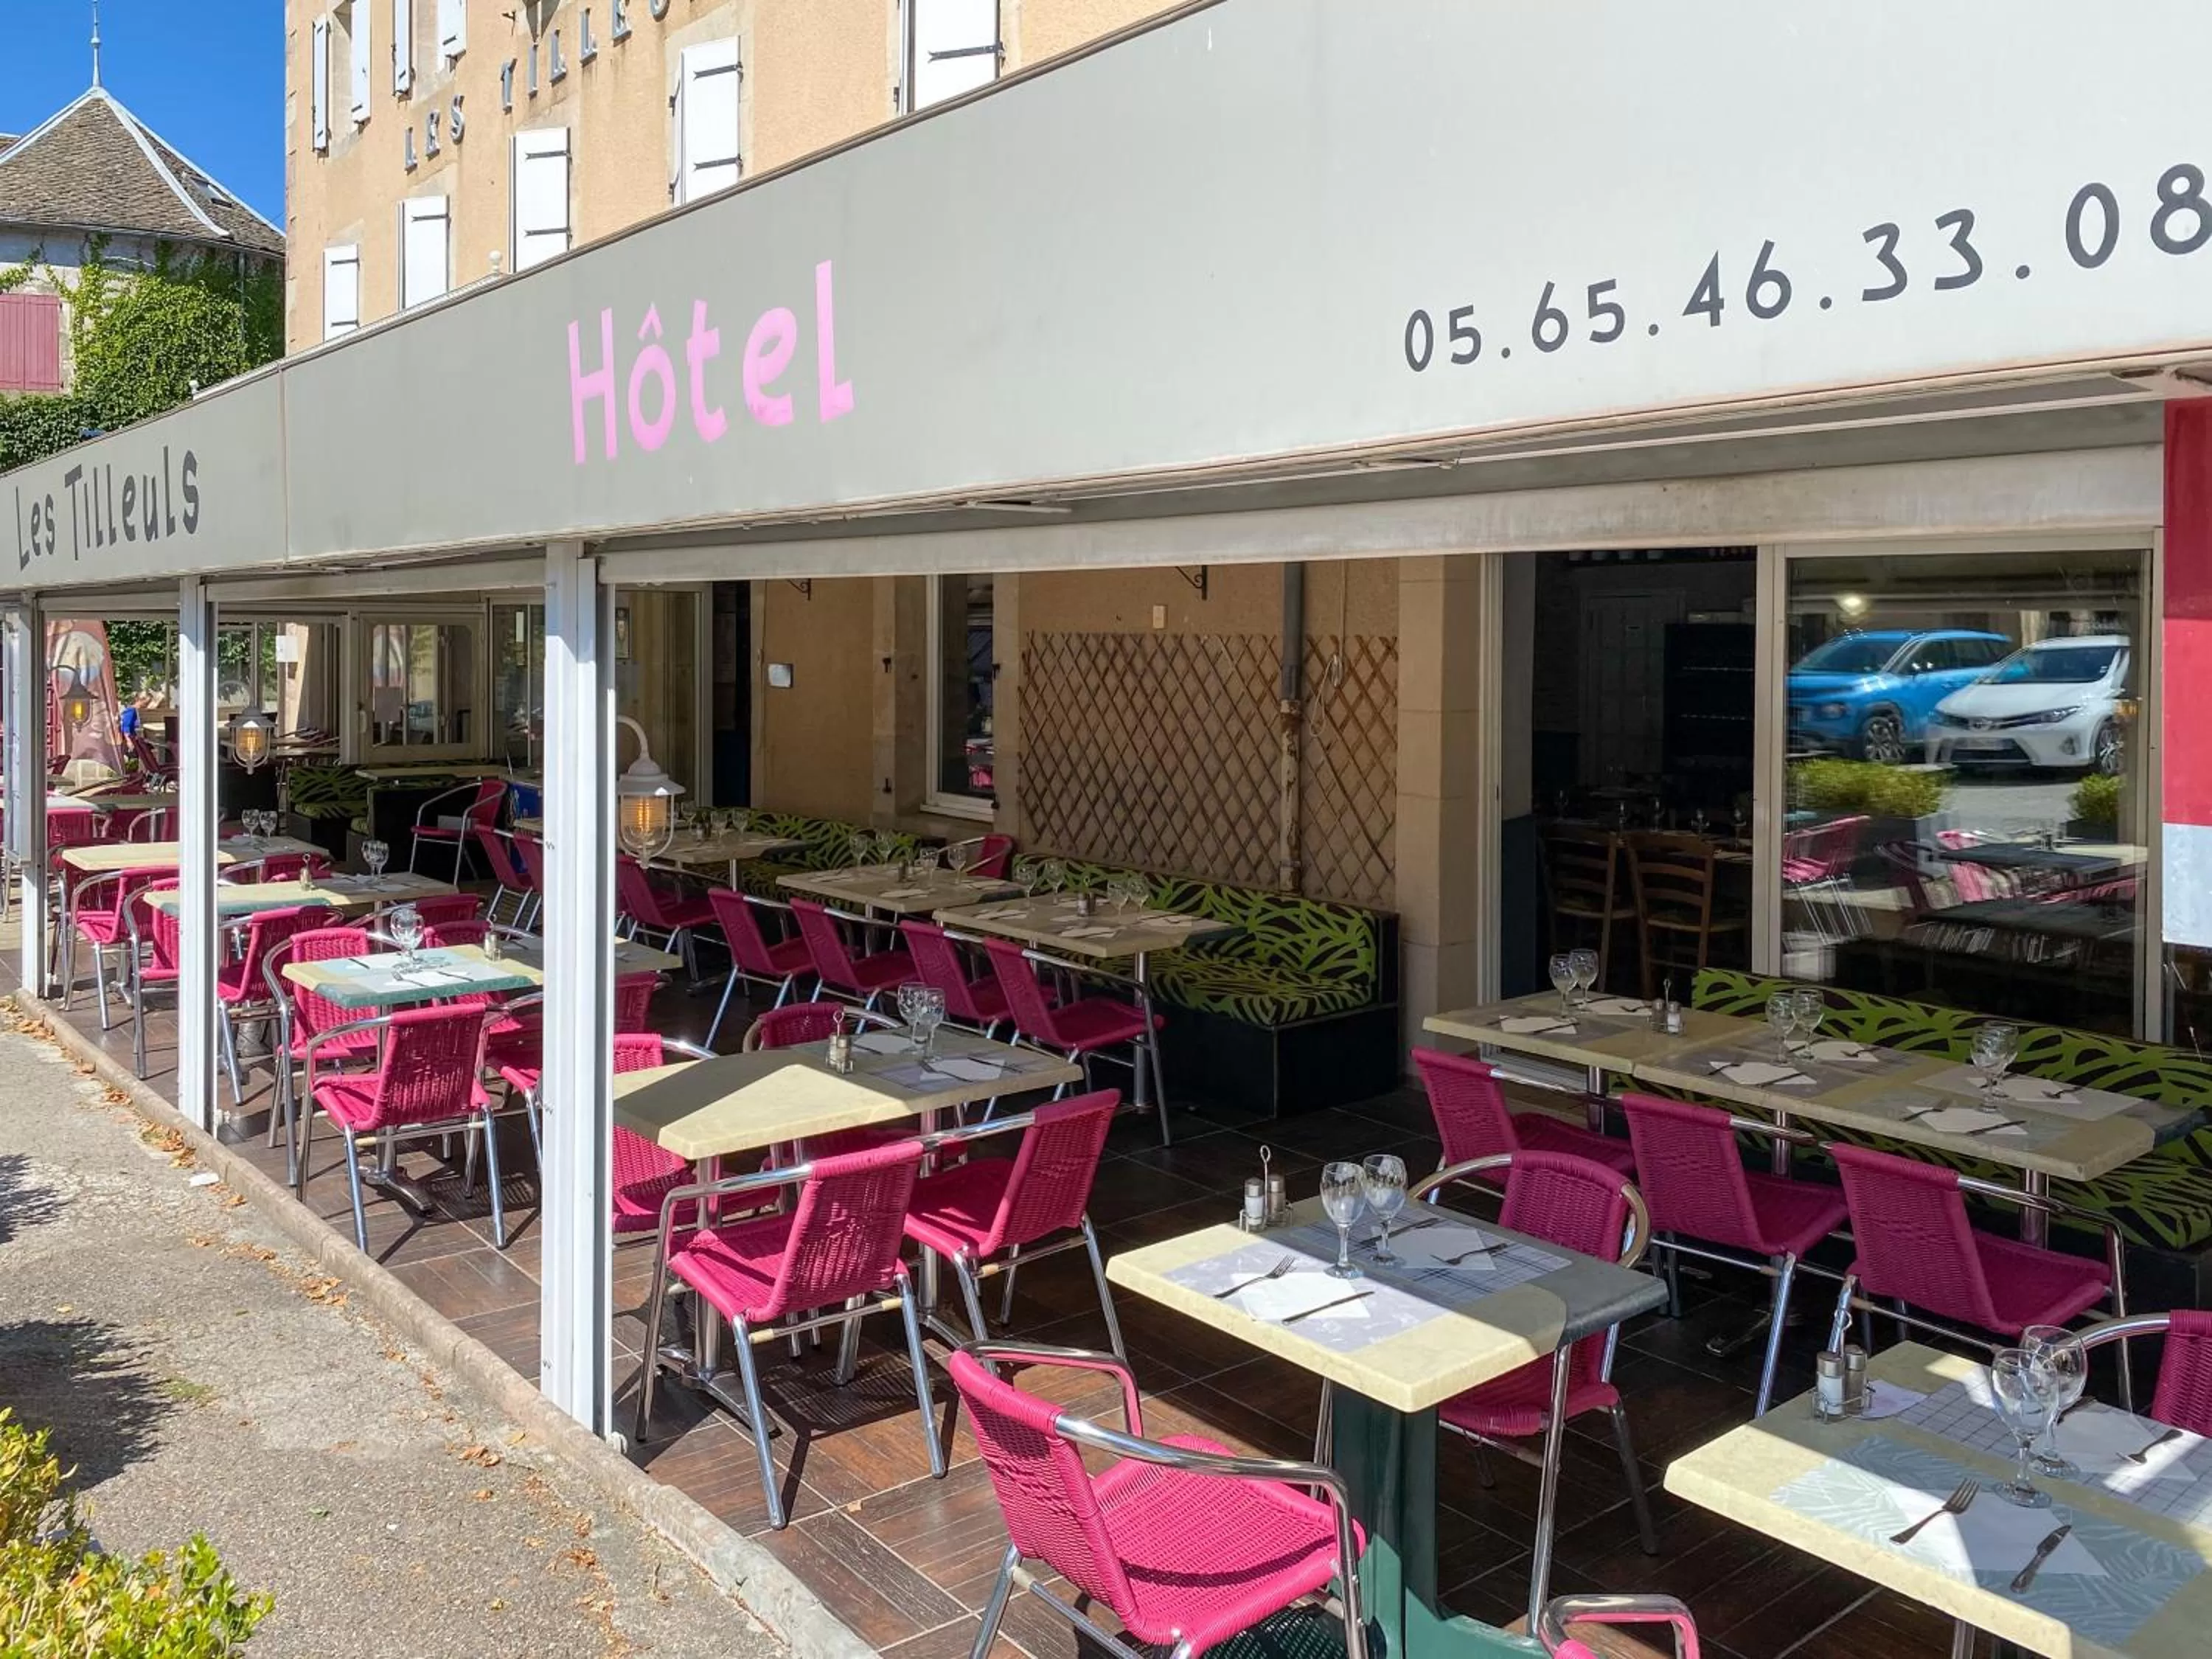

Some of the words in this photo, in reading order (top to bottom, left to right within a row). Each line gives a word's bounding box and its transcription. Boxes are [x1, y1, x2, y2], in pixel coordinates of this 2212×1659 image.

[405, 94, 465, 175] LES
[1405, 163, 2212, 372] 05.65.46.33.08
[568, 259, 855, 465] Hôtel
[15, 485, 56, 572] Les
